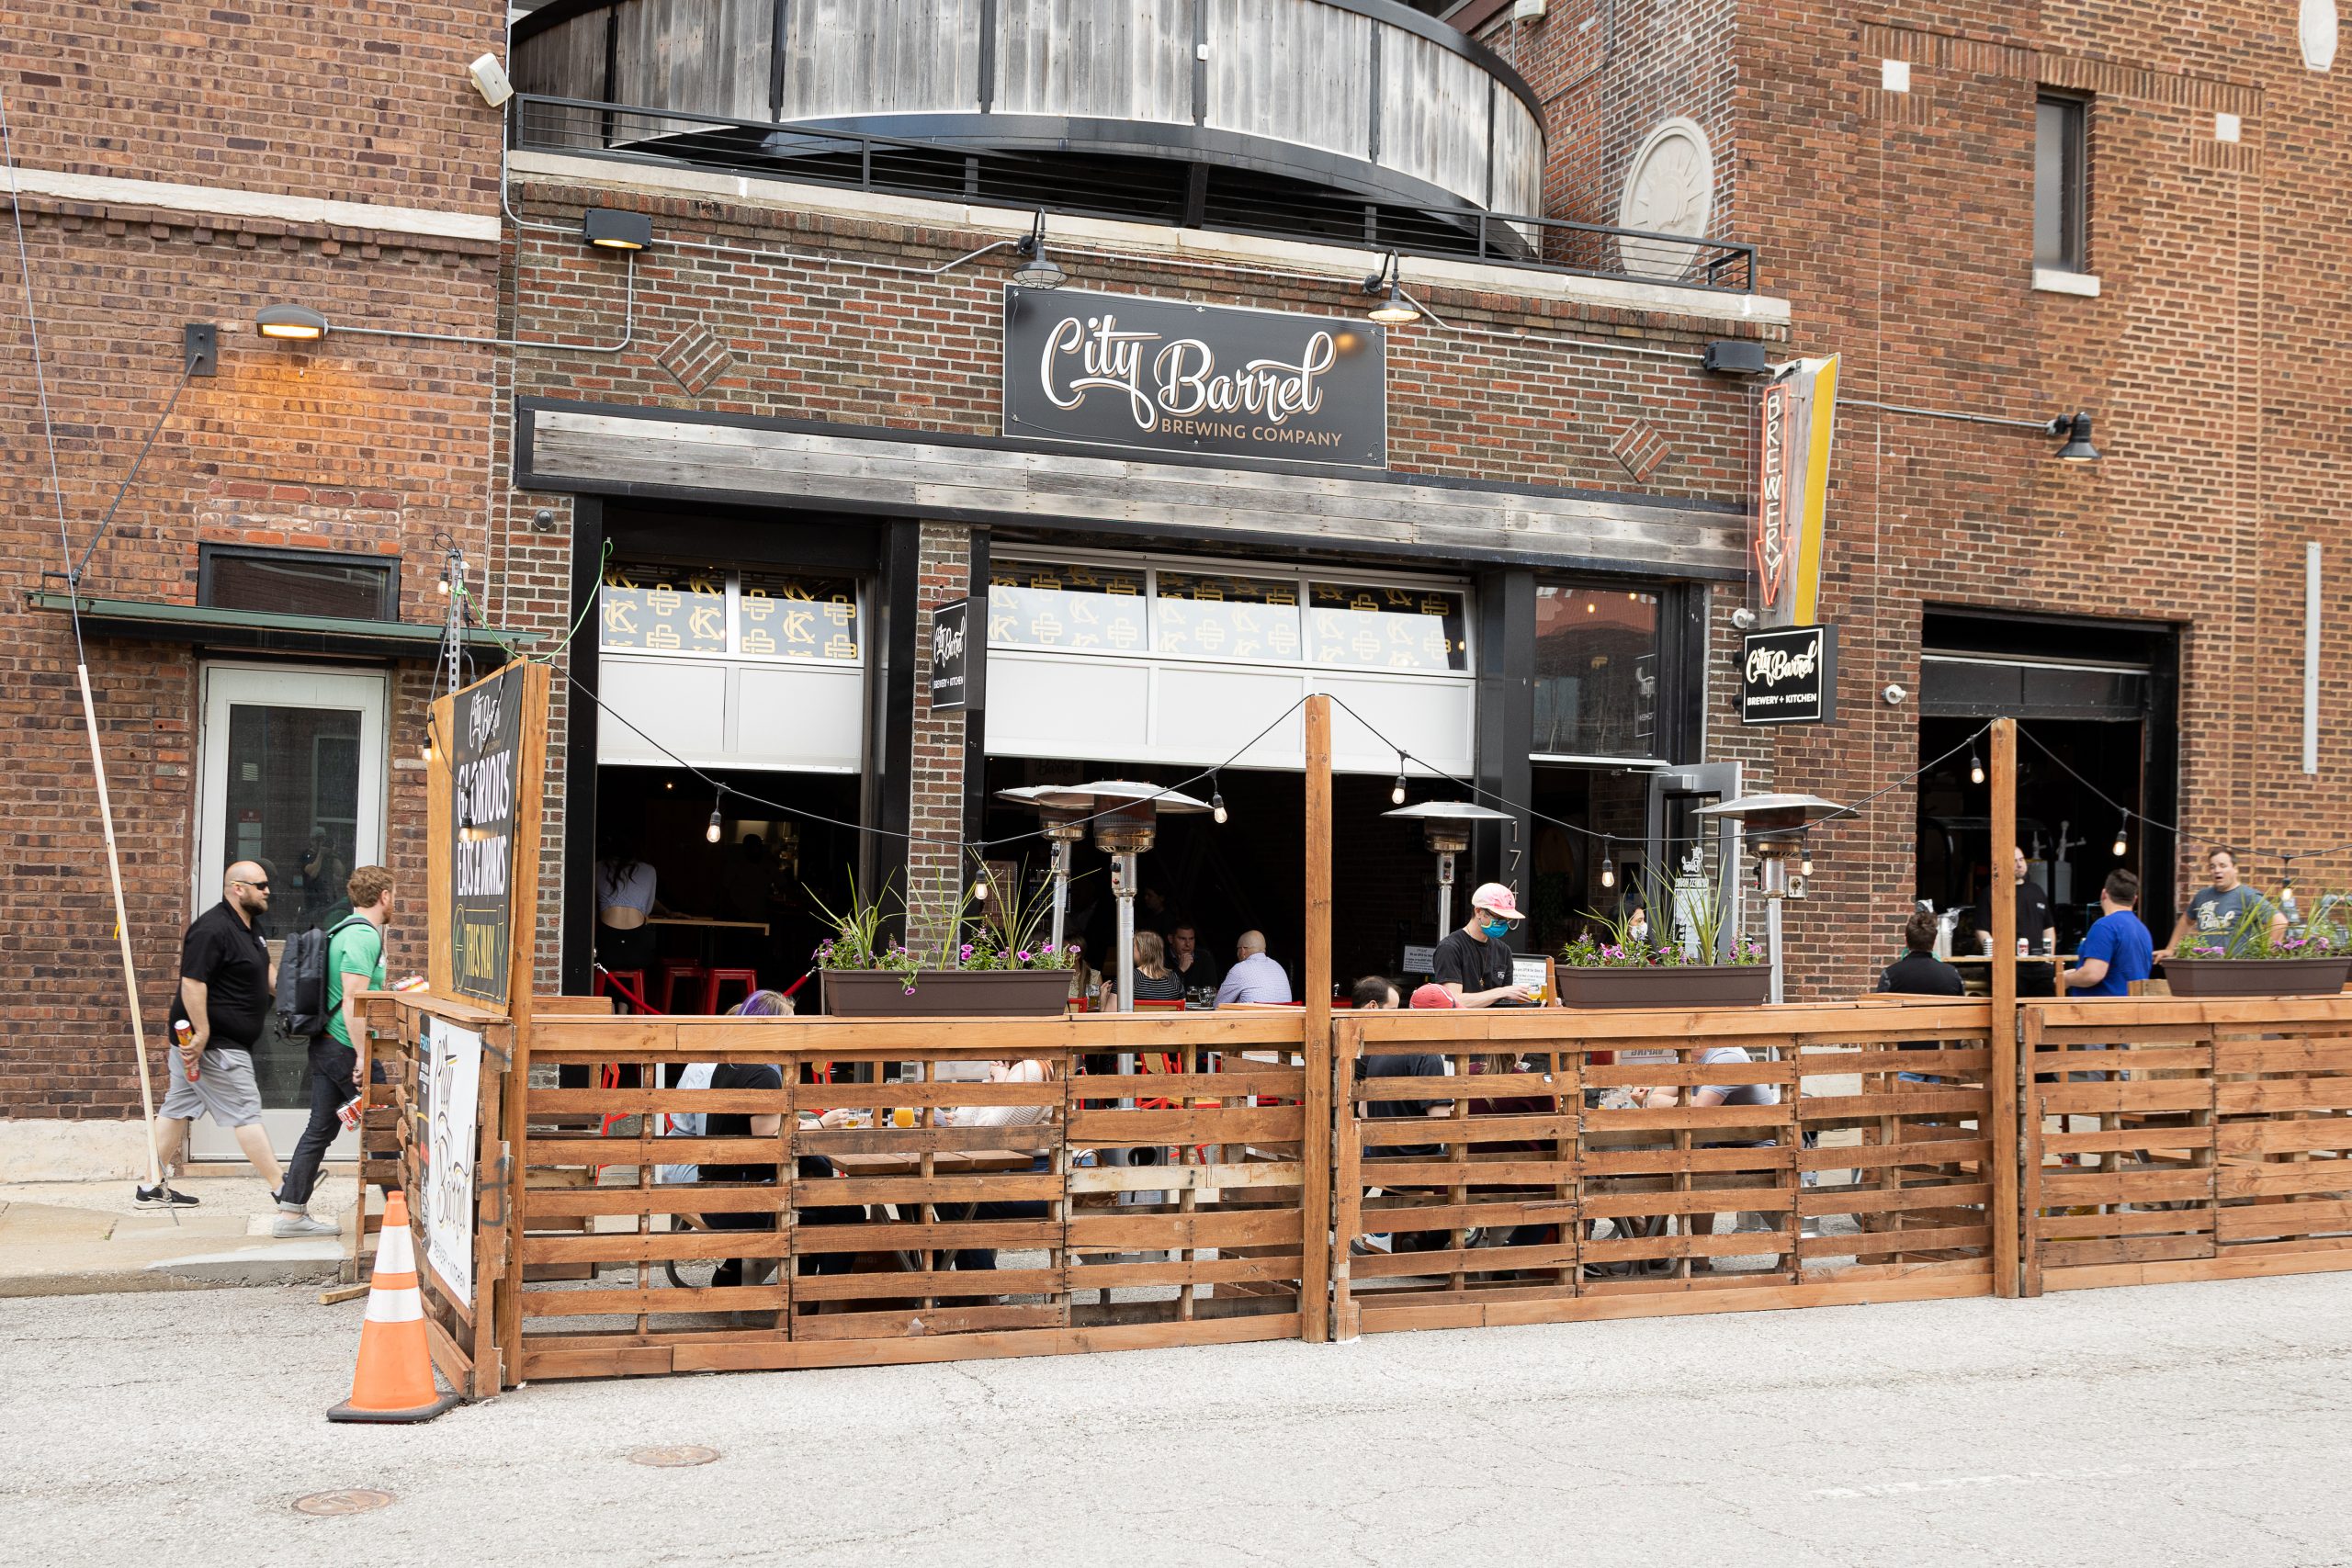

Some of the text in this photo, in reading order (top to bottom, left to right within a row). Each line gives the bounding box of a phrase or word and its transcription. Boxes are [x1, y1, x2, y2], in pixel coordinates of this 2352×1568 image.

[1041, 314, 1337, 432] City Barrel
[1161, 418, 1342, 448] BREWING COMPANY
[1763, 394, 1782, 580] BREWERY
[1746, 640, 1818, 687] City Barrel
[1747, 695, 1779, 705] BREWERY
[1785, 694, 1817, 704] KITCHEN
[458, 750, 510, 827] GLORIOUS
[458, 840, 473, 896] EATS
[481, 835, 506, 896] DRINKS
[465, 923, 495, 980] THIS WAY
